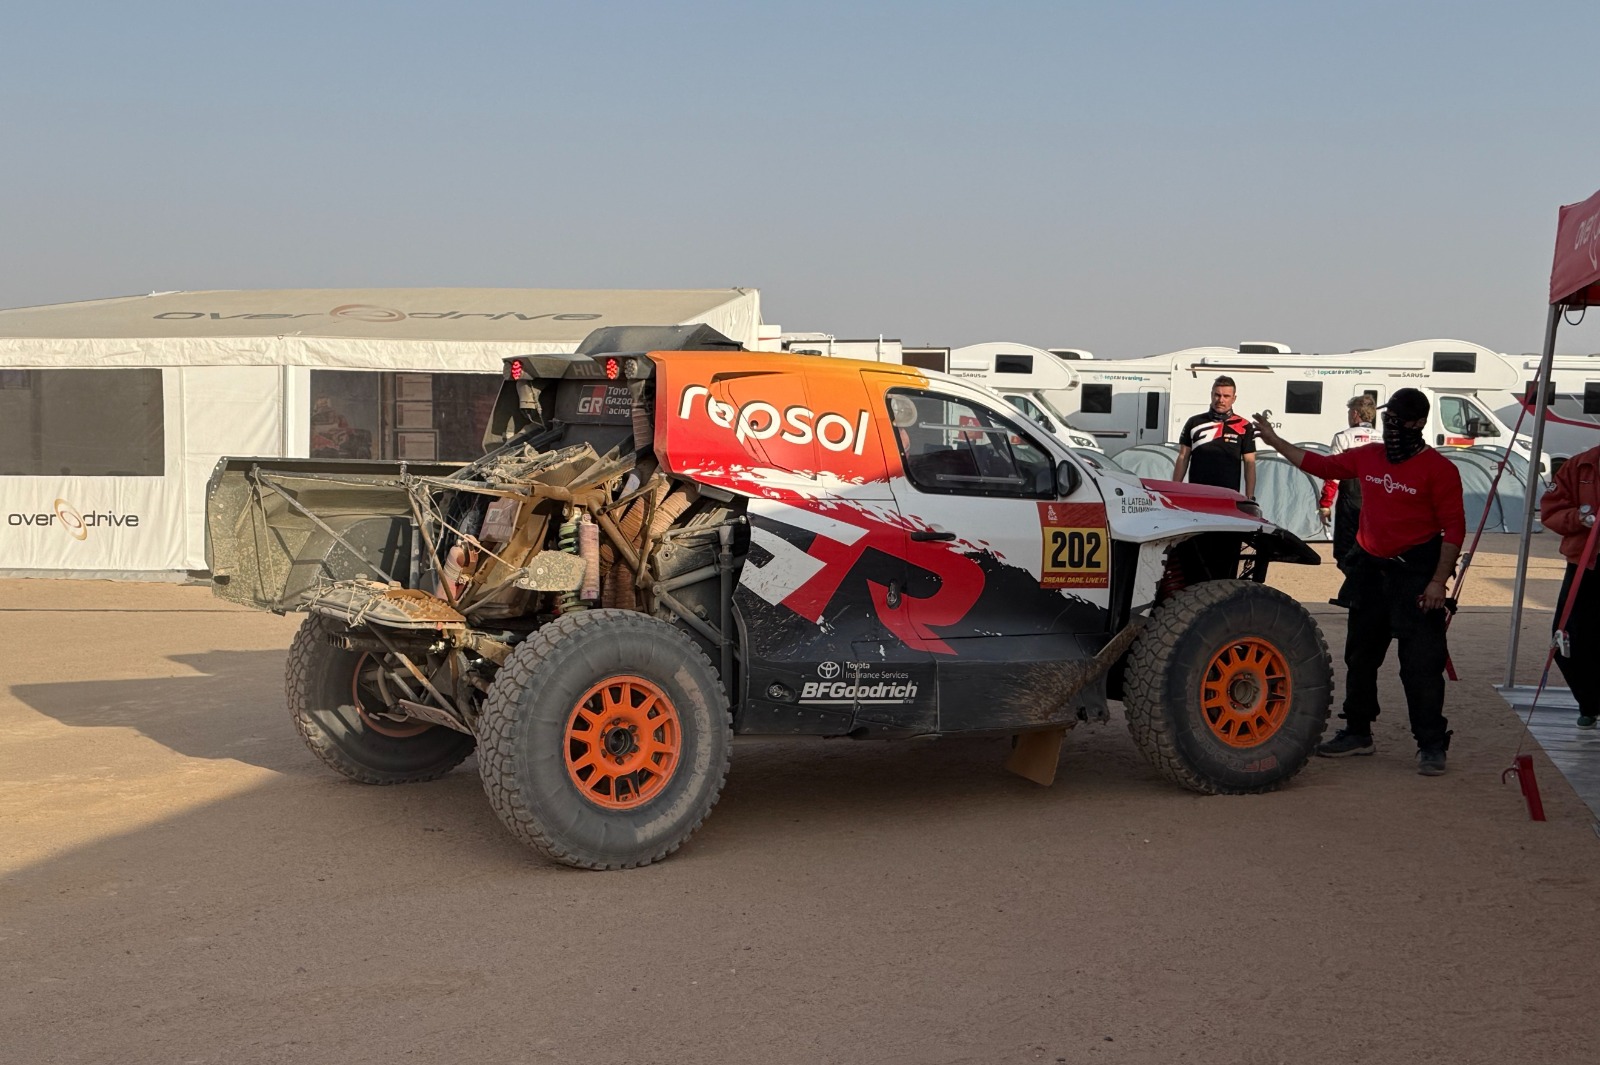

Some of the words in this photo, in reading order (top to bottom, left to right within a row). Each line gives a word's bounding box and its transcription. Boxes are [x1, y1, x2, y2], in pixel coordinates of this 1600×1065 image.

[407, 310, 602, 321] drive
[573, 364, 602, 376] HIL
[608, 386, 631, 396] TOYO
[578, 397, 603, 413] GR
[605, 396, 633, 405] GAZOO
[678, 384, 870, 456] repsol
[8, 513, 56, 526] over
[83, 510, 139, 527] drive
[1051, 531, 1101, 568] 202
[846, 661, 870, 670] Toyota
[845, 671, 880, 679] Insurance
[881, 671, 909, 679] Services
[800, 680, 918, 698] BFGoodrich
